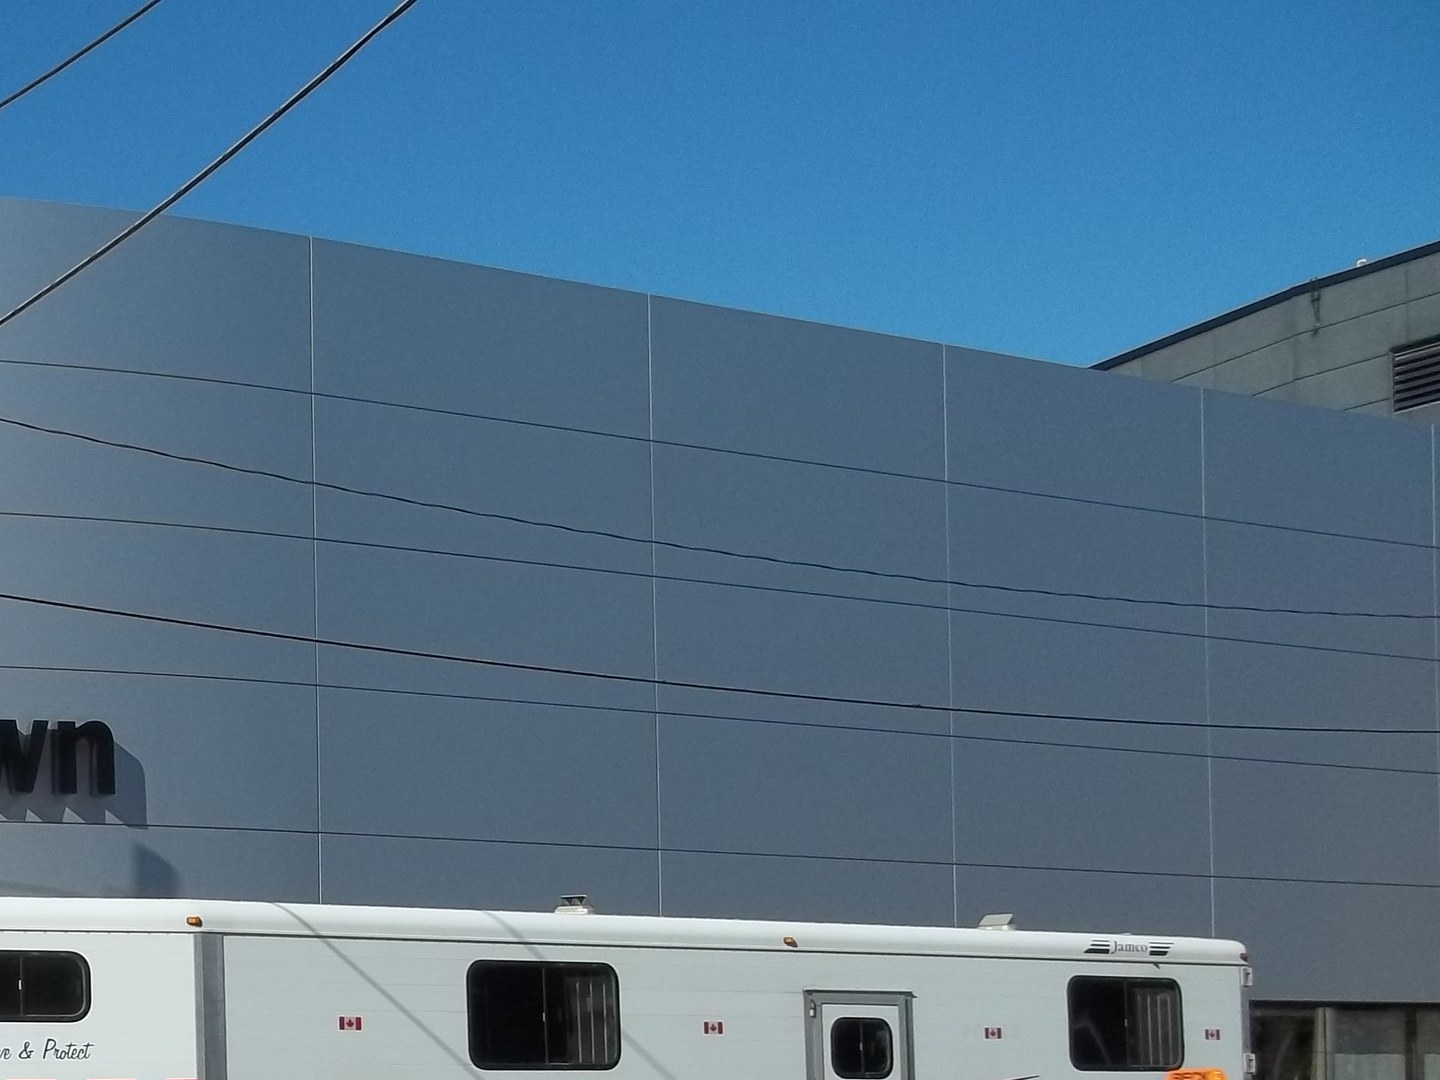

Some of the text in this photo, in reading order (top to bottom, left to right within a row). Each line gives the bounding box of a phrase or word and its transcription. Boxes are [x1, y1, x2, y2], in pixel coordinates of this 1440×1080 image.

[1110, 940, 1148, 955] Jamco
[18, 1041, 35, 1060] &
[42, 1038, 95, 1060] Protect
